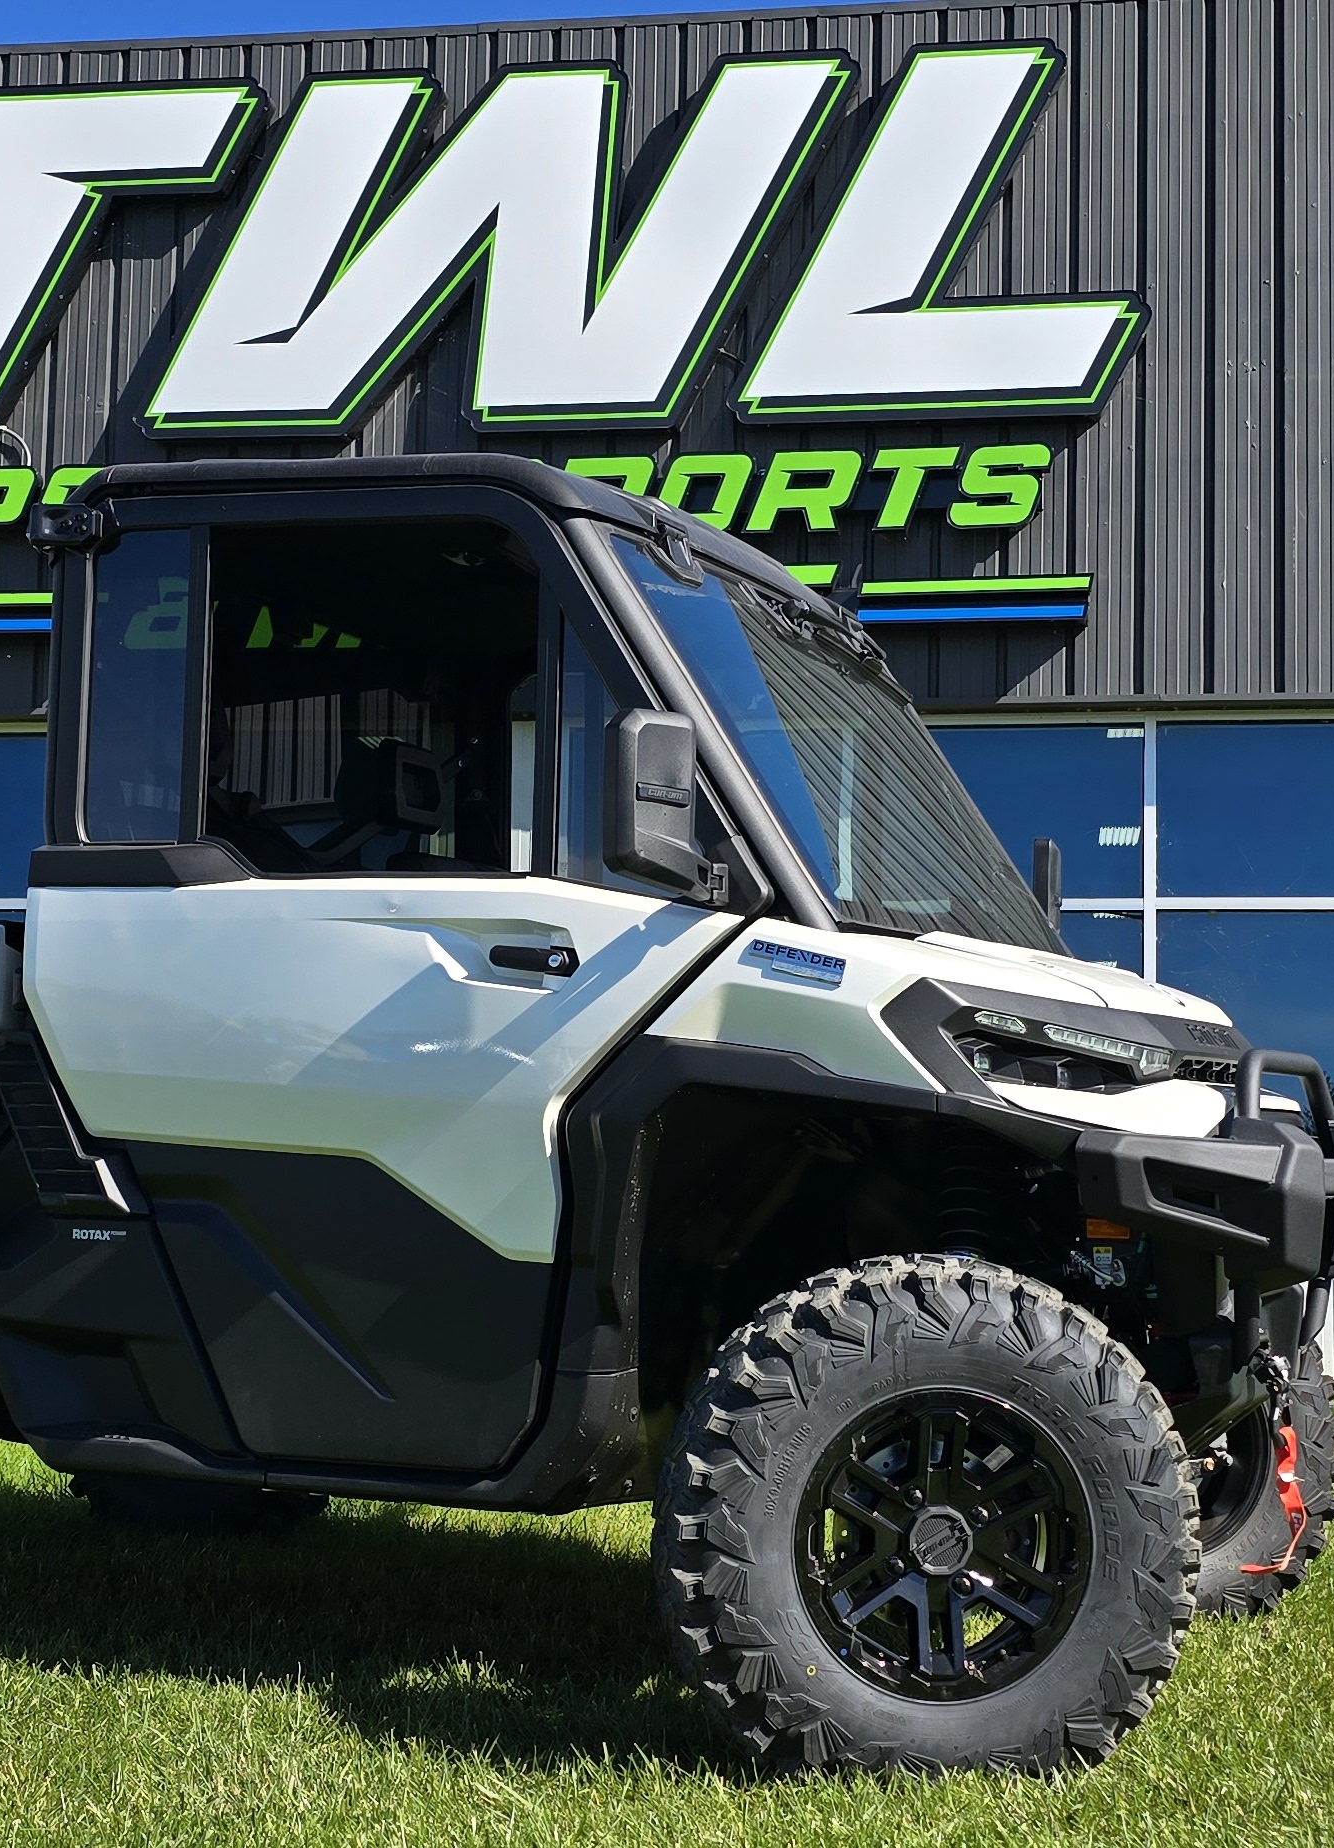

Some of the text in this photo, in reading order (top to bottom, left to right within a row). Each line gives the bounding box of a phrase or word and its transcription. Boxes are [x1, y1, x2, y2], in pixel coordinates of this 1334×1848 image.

[753, 940, 846, 971] DEFENDER
[72, 1228, 111, 1241] ROTAX
[1080, 1454, 1123, 1582] FORCE
